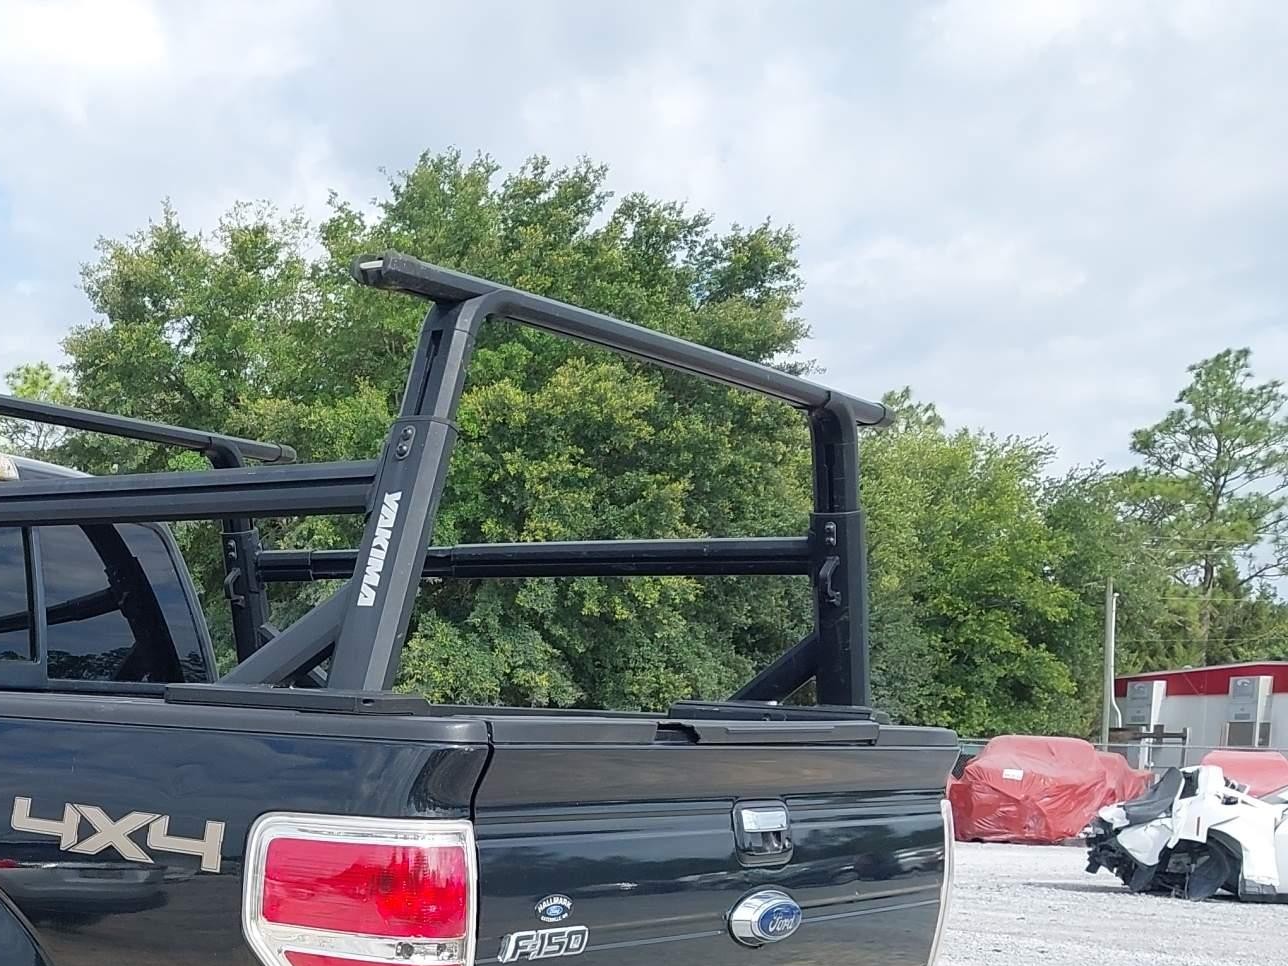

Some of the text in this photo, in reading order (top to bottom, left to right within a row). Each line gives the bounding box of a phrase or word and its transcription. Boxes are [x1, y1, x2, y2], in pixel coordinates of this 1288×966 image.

[356, 491, 402, 607] YAKIMA
[537, 896, 572, 914] HALLMARK
[768, 908, 798, 933] Ford
[503, 925, 589, 963] F-150
